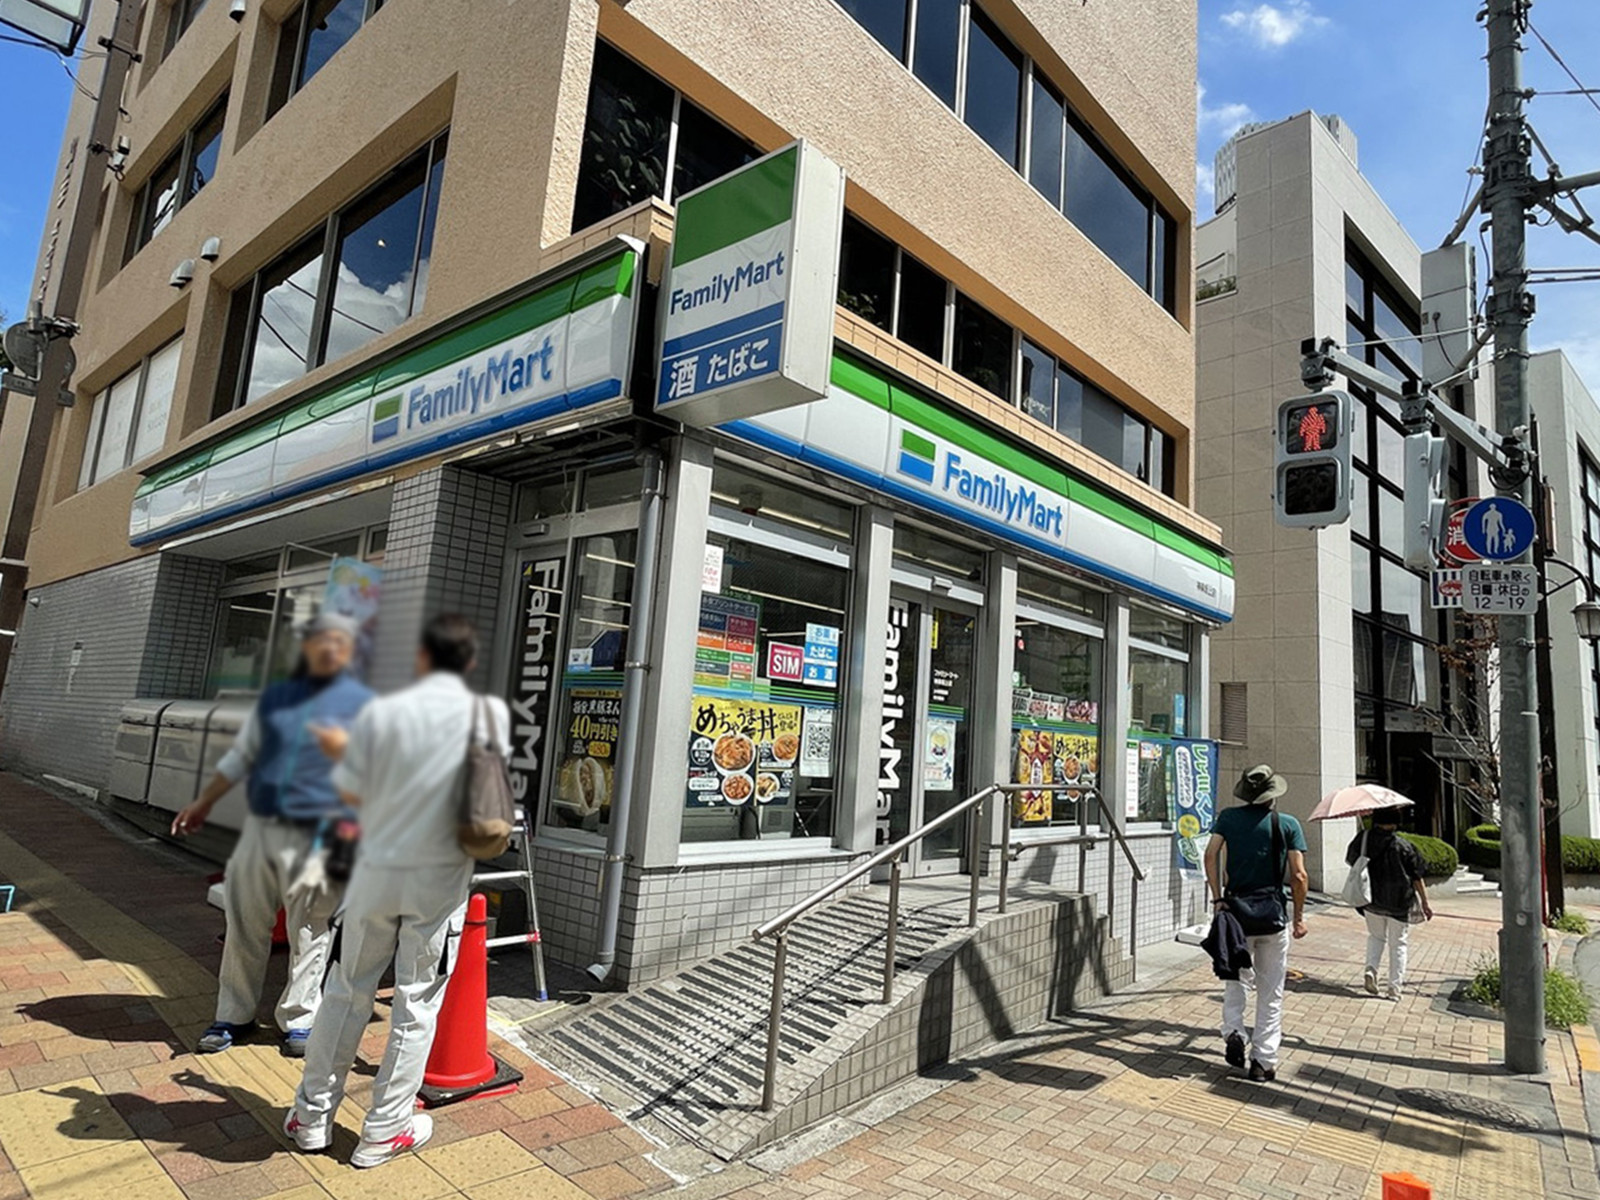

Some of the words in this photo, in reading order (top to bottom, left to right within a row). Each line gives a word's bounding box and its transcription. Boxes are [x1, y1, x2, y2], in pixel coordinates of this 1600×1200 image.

[670, 251, 785, 315] FamilyMart
[406, 334, 554, 430] FamilyMart
[668, 355, 699, 398] 酒
[706, 338, 769, 384] たばこ
[943, 451, 1063, 538] FamilyMart
[1469, 569, 1531, 581] 自転車を除く
[772, 653, 800, 676] SIM
[695, 703, 778, 740] めちゃうま丼
